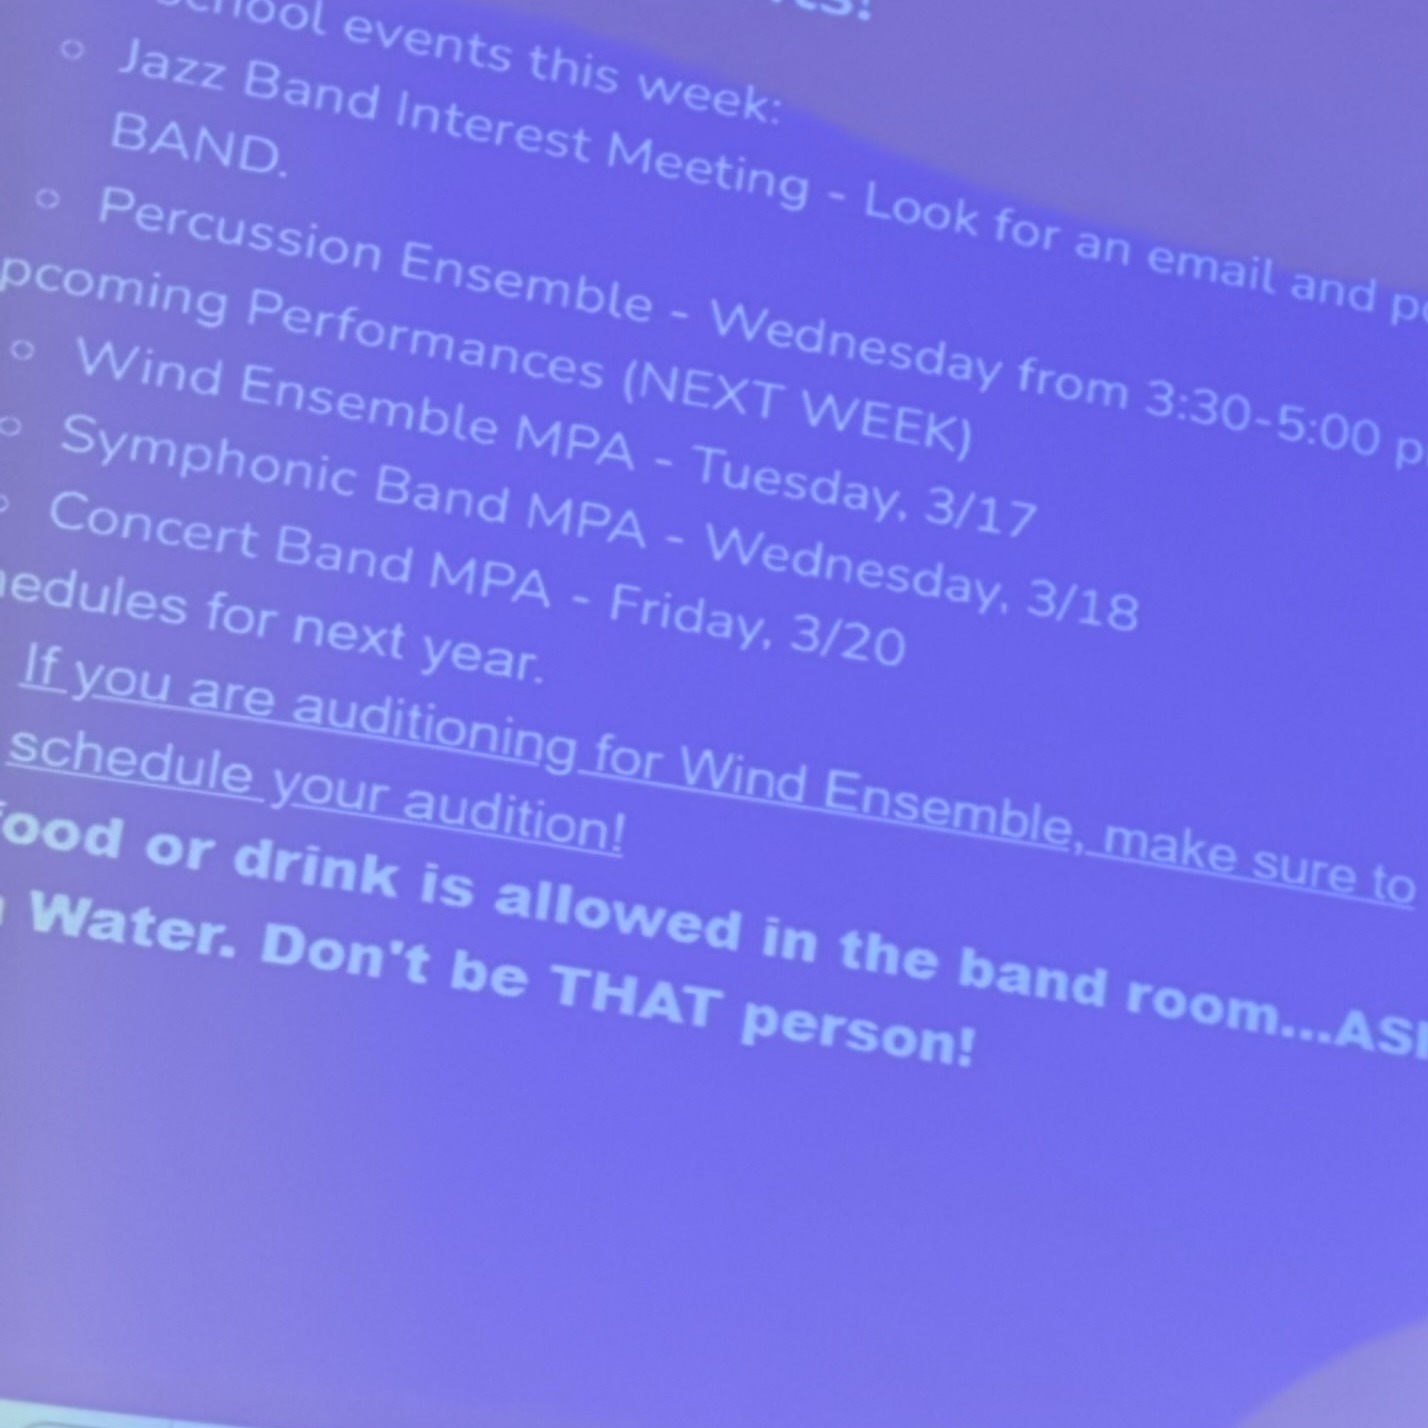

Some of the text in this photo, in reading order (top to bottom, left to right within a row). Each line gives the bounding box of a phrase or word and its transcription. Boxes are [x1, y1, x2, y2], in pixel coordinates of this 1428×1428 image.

[111, 112, 288, 177] BAND.
[344, 15, 511, 73] events
[529, 45, 619, 94] this
[638, 69, 782, 127] week:
[118, 37, 227, 92] Jazz
[243, 60, 380, 121] Band
[396, 91, 591, 163] Interest
[606, 132, 809, 211] Meeting
[865, 181, 979, 236] Look
[993, 207, 1060, 251] for
[1076, 232, 1130, 266] an
[1147, 243, 1276, 295] email
[1290, 264, 1377, 313] and
[98, 186, 382, 273] Percussion
[401, 243, 654, 323] Ensemble
[710, 299, 1002, 392] Wednesday
[1017, 357, 1129, 409] from
[1146, 381, 1381, 456] 3:30-5:00
[247, 289, 604, 389] Performances
[622, 360, 786, 421] (NEXT
[802, 392, 973, 463] WEEK)
[61, 413, 357, 499] Symphonic
[375, 465, 510, 526] Band
[527, 494, 647, 551] MPA
[1026, 578, 1141, 635] 3/18
[76, 335, 222, 397] Wind
[241, 365, 499, 447] Ensemble
[515, 416, 635, 473] MPA
[925, 486, 1037, 542] 3/17
[49, 490, 261, 560] Concert
[275, 526, 413, 585] Band
[429, 552, 550, 611] MPA
[609, 585, 773, 656] Friday,
[789, 615, 907, 668] 3/20
[207, 591, 279, 644] for
[292, 613, 406, 663] next
[422, 633, 546, 688] year.
[9, 729, 627, 855] schedule your audition!
[24, 642, 1418, 907] If you are auditioning for Wind Ensemble, make sure to
[0, 802, 125, 859] ood
[145, 832, 217, 872] or
[234, 839, 400, 900] drink
[420, 862, 476, 909] is
[493, 880, 743, 953] allowed
[761, 917, 818, 964] in
[840, 929, 940, 982] the
[958, 946, 1108, 1008] band
[29, 888, 236, 960] Water.
[260, 923, 431, 988] Don't
[448, 949, 530, 999] be
[549, 964, 724, 1030] THAT
[741, 994, 976, 1069] person!
